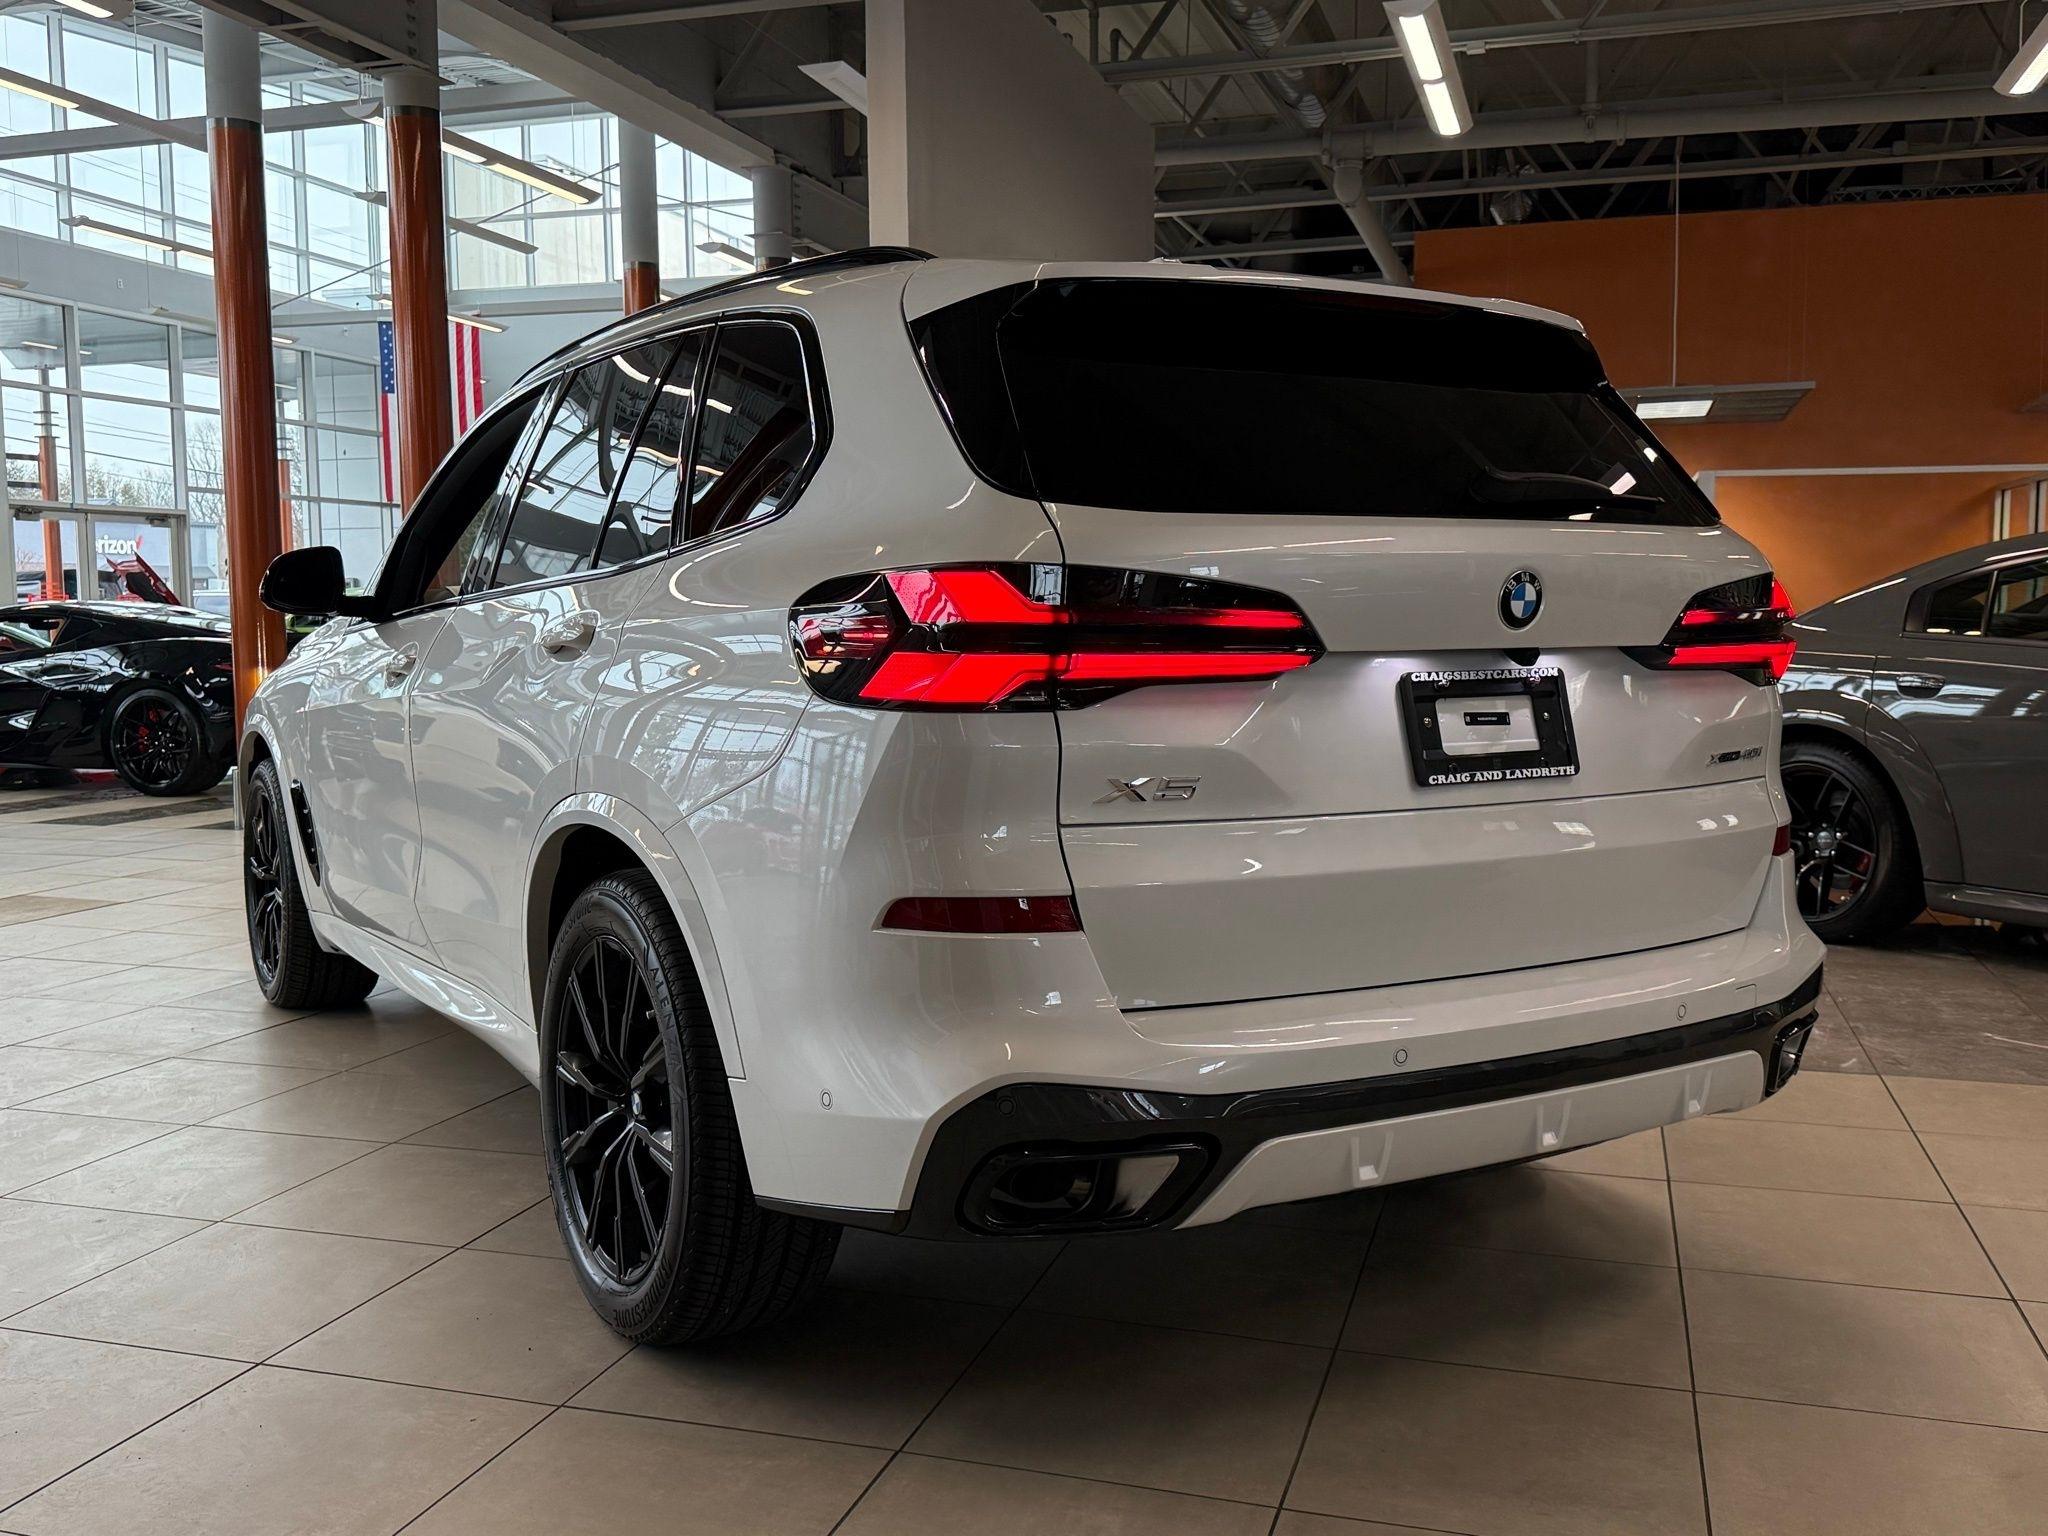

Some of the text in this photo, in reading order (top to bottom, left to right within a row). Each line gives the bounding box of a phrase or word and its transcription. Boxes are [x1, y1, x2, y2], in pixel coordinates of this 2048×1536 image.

[1506, 572, 1541, 591] BMW
[1411, 667, 1559, 682] CRAIGSBESTCARS.COM
[1428, 765, 1576, 785] CRAIG AND LANDRETH
[1093, 775, 1201, 804] X5
